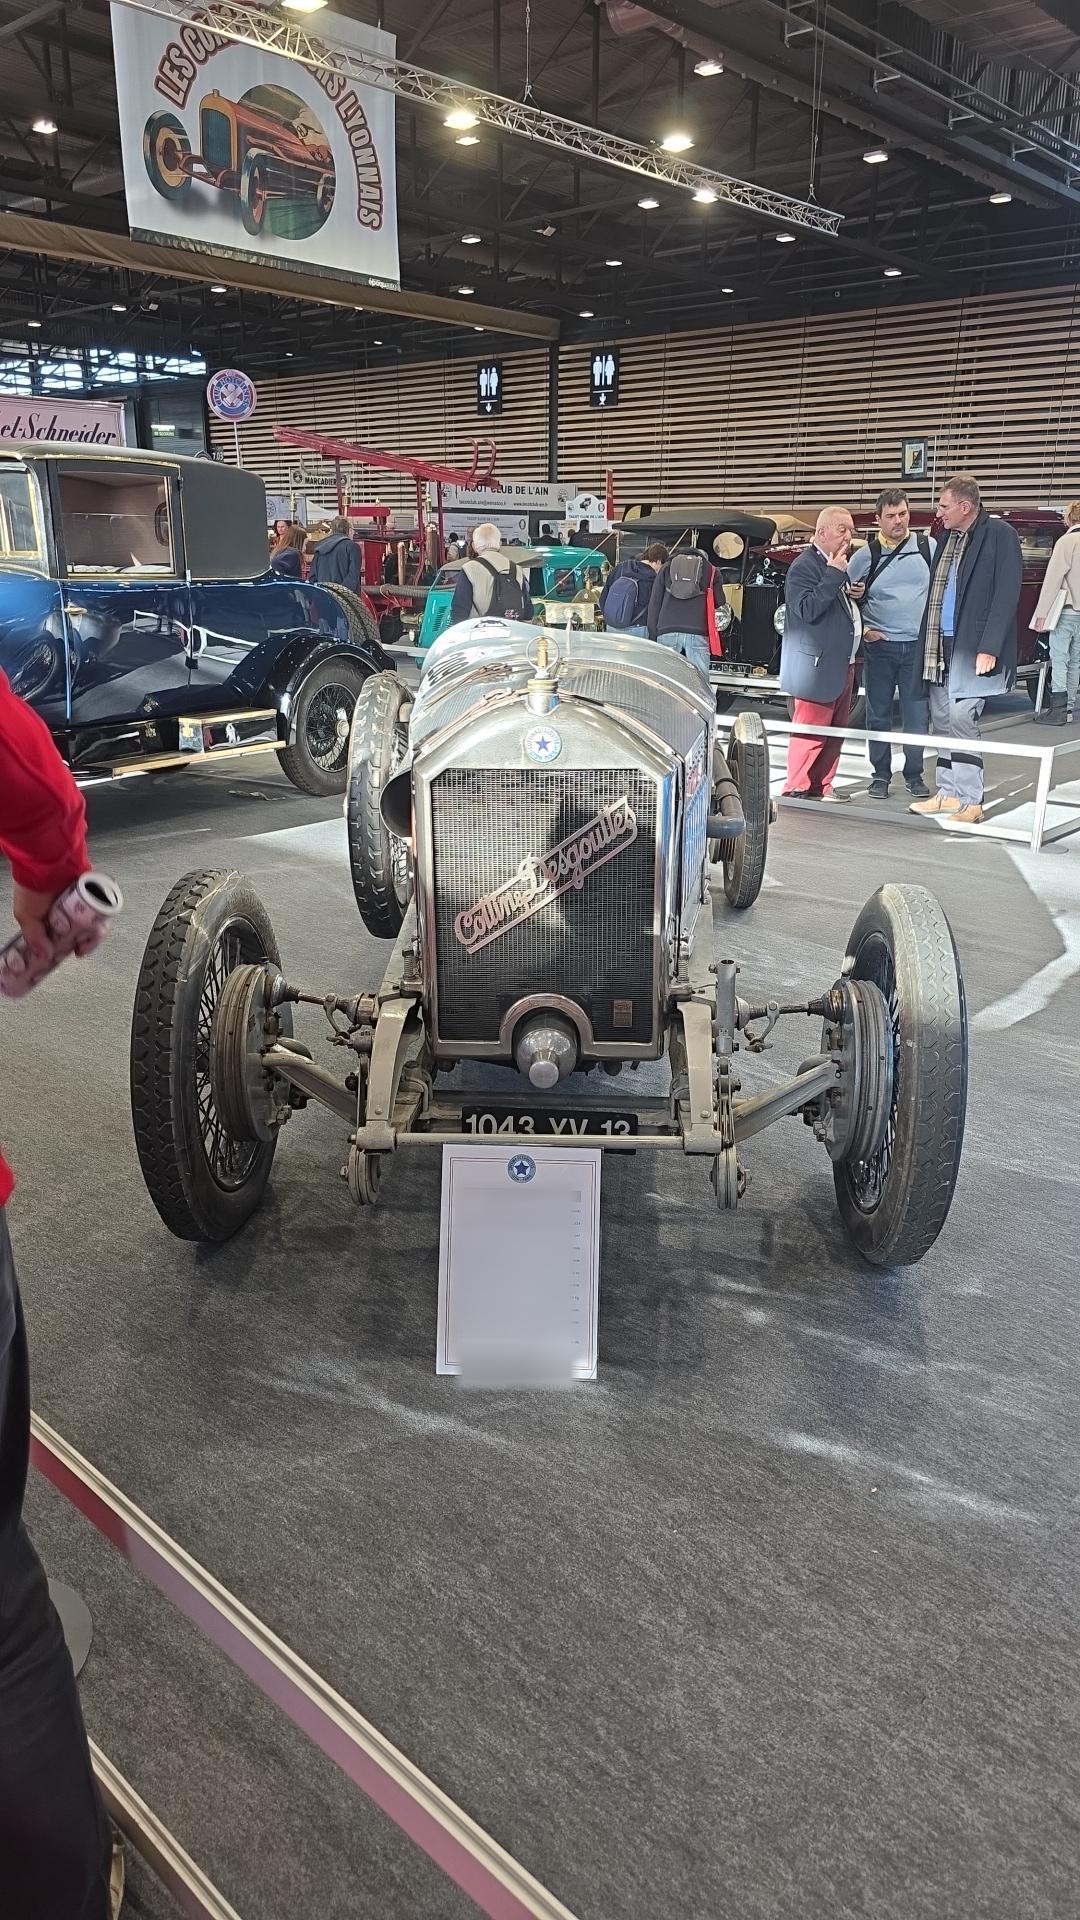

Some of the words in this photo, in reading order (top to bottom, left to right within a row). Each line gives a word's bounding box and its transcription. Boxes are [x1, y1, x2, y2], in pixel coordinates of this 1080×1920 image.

[154, 41, 198, 110] LES
[335, 89, 384, 232] LYONNAIS
[0, 412, 117, 444] et-Schneider
[305, 477, 337, 486] MARCADIER
[490, 485, 513, 494] CLUB
[515, 486, 526, 495] DE
[528, 486, 549, 496] L'AIN
[465, 1113, 536, 1135] 1043
[549, 1117, 589, 1136] YV
